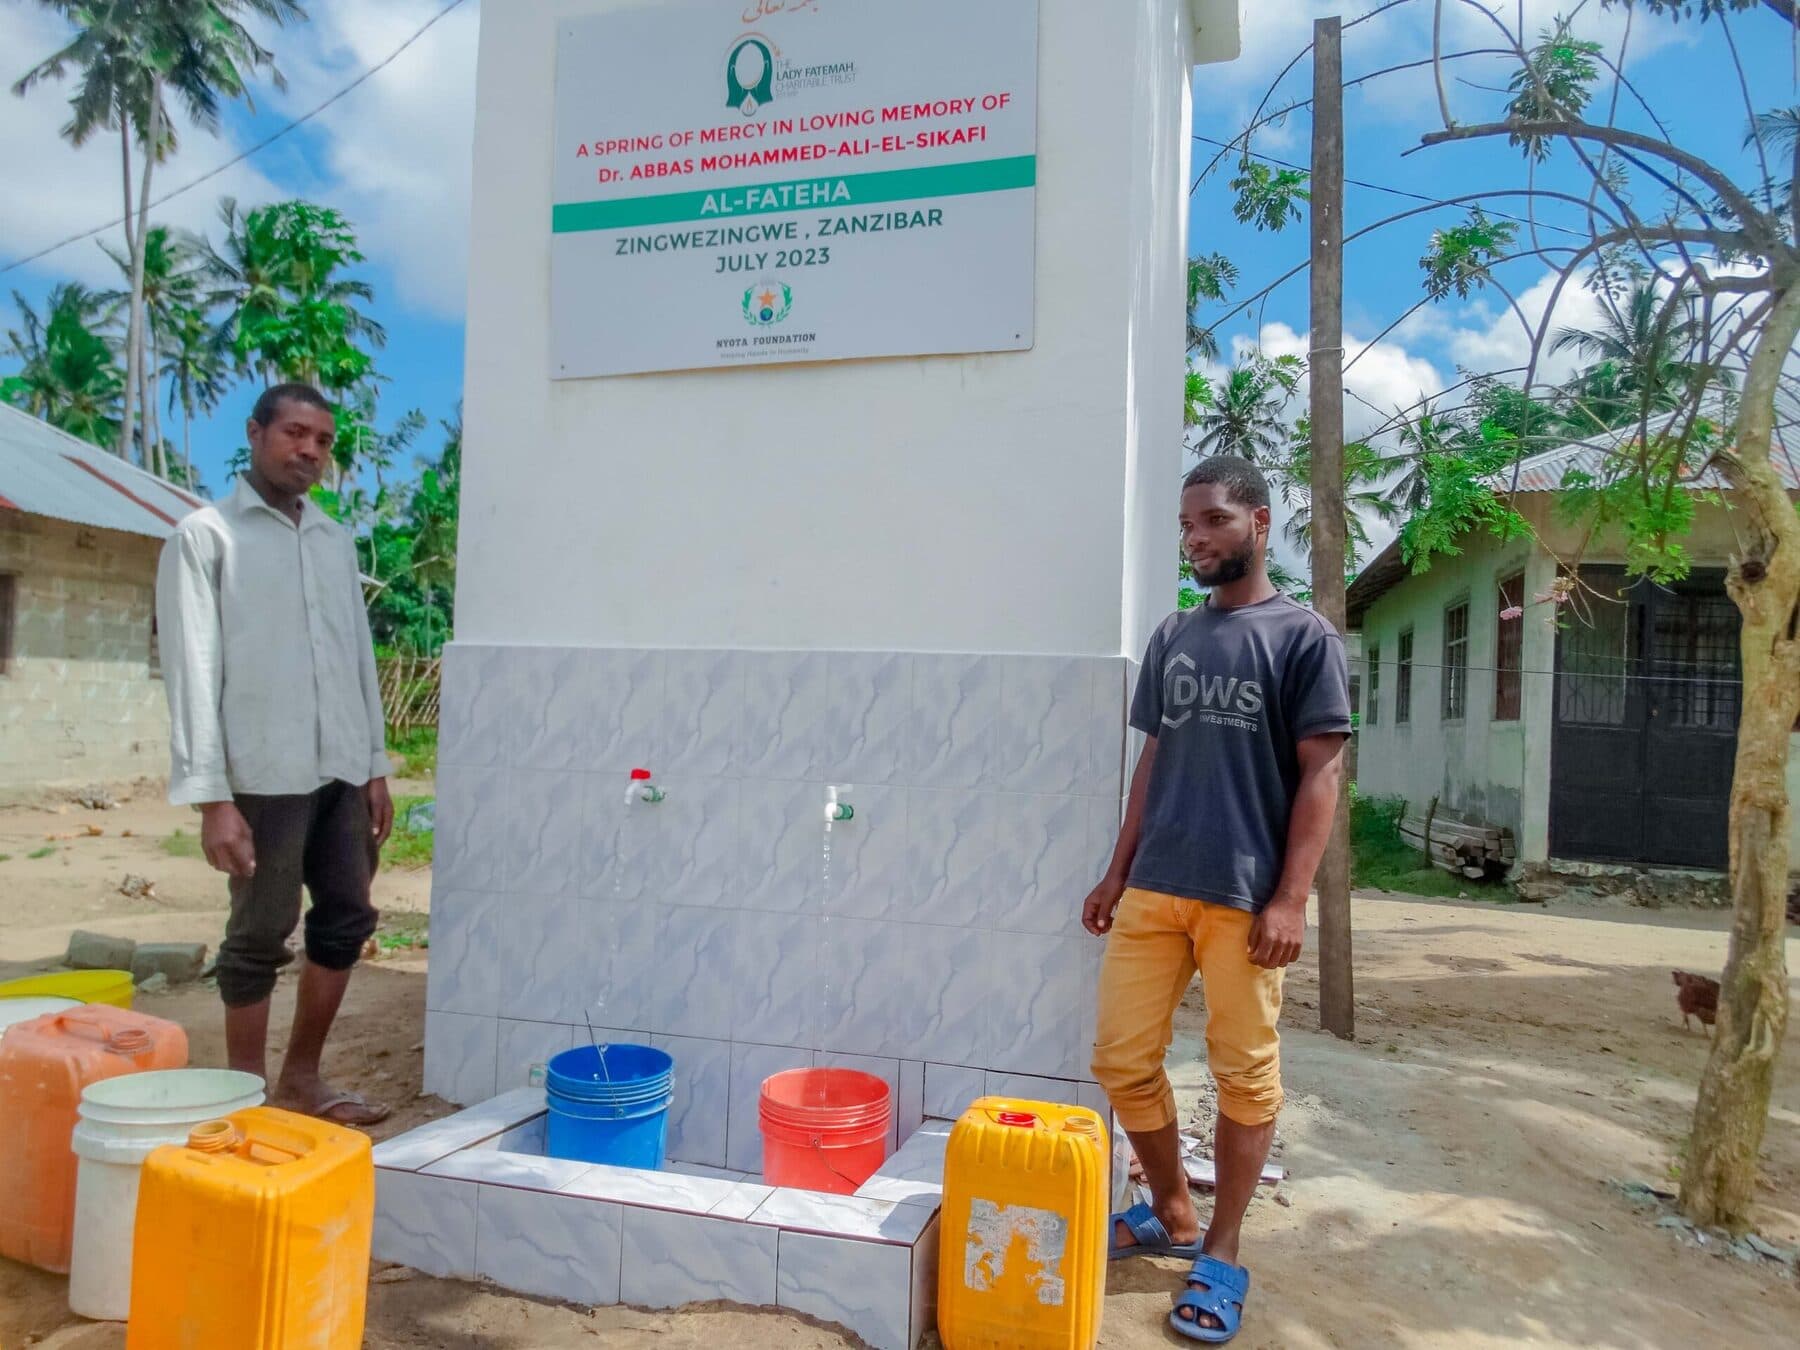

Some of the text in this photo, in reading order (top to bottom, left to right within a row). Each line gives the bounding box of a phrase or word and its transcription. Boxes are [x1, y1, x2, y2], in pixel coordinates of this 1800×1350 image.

[776, 62, 854, 81] LADY FATEMAH
[830, 73, 856, 84] TRUST
[576, 93, 1010, 158] A SPRING OF MERCY IN LOVING MEMORY OF
[598, 126, 987, 183] Dr. ABBAS MOHAMMED-ALI-EL-SIKAFI
[700, 179, 851, 215] AL-FATEHA
[615, 222, 798, 256] ZINGWEZINGWE
[817, 209, 943, 237] ZANZIBAR
[715, 247, 830, 273] JULY 2023
[716, 333, 817, 348] NYOTA FOUNDATION
[1173, 674, 1262, 714] DWS
[1200, 714, 1258, 732] INVESTMENTS
